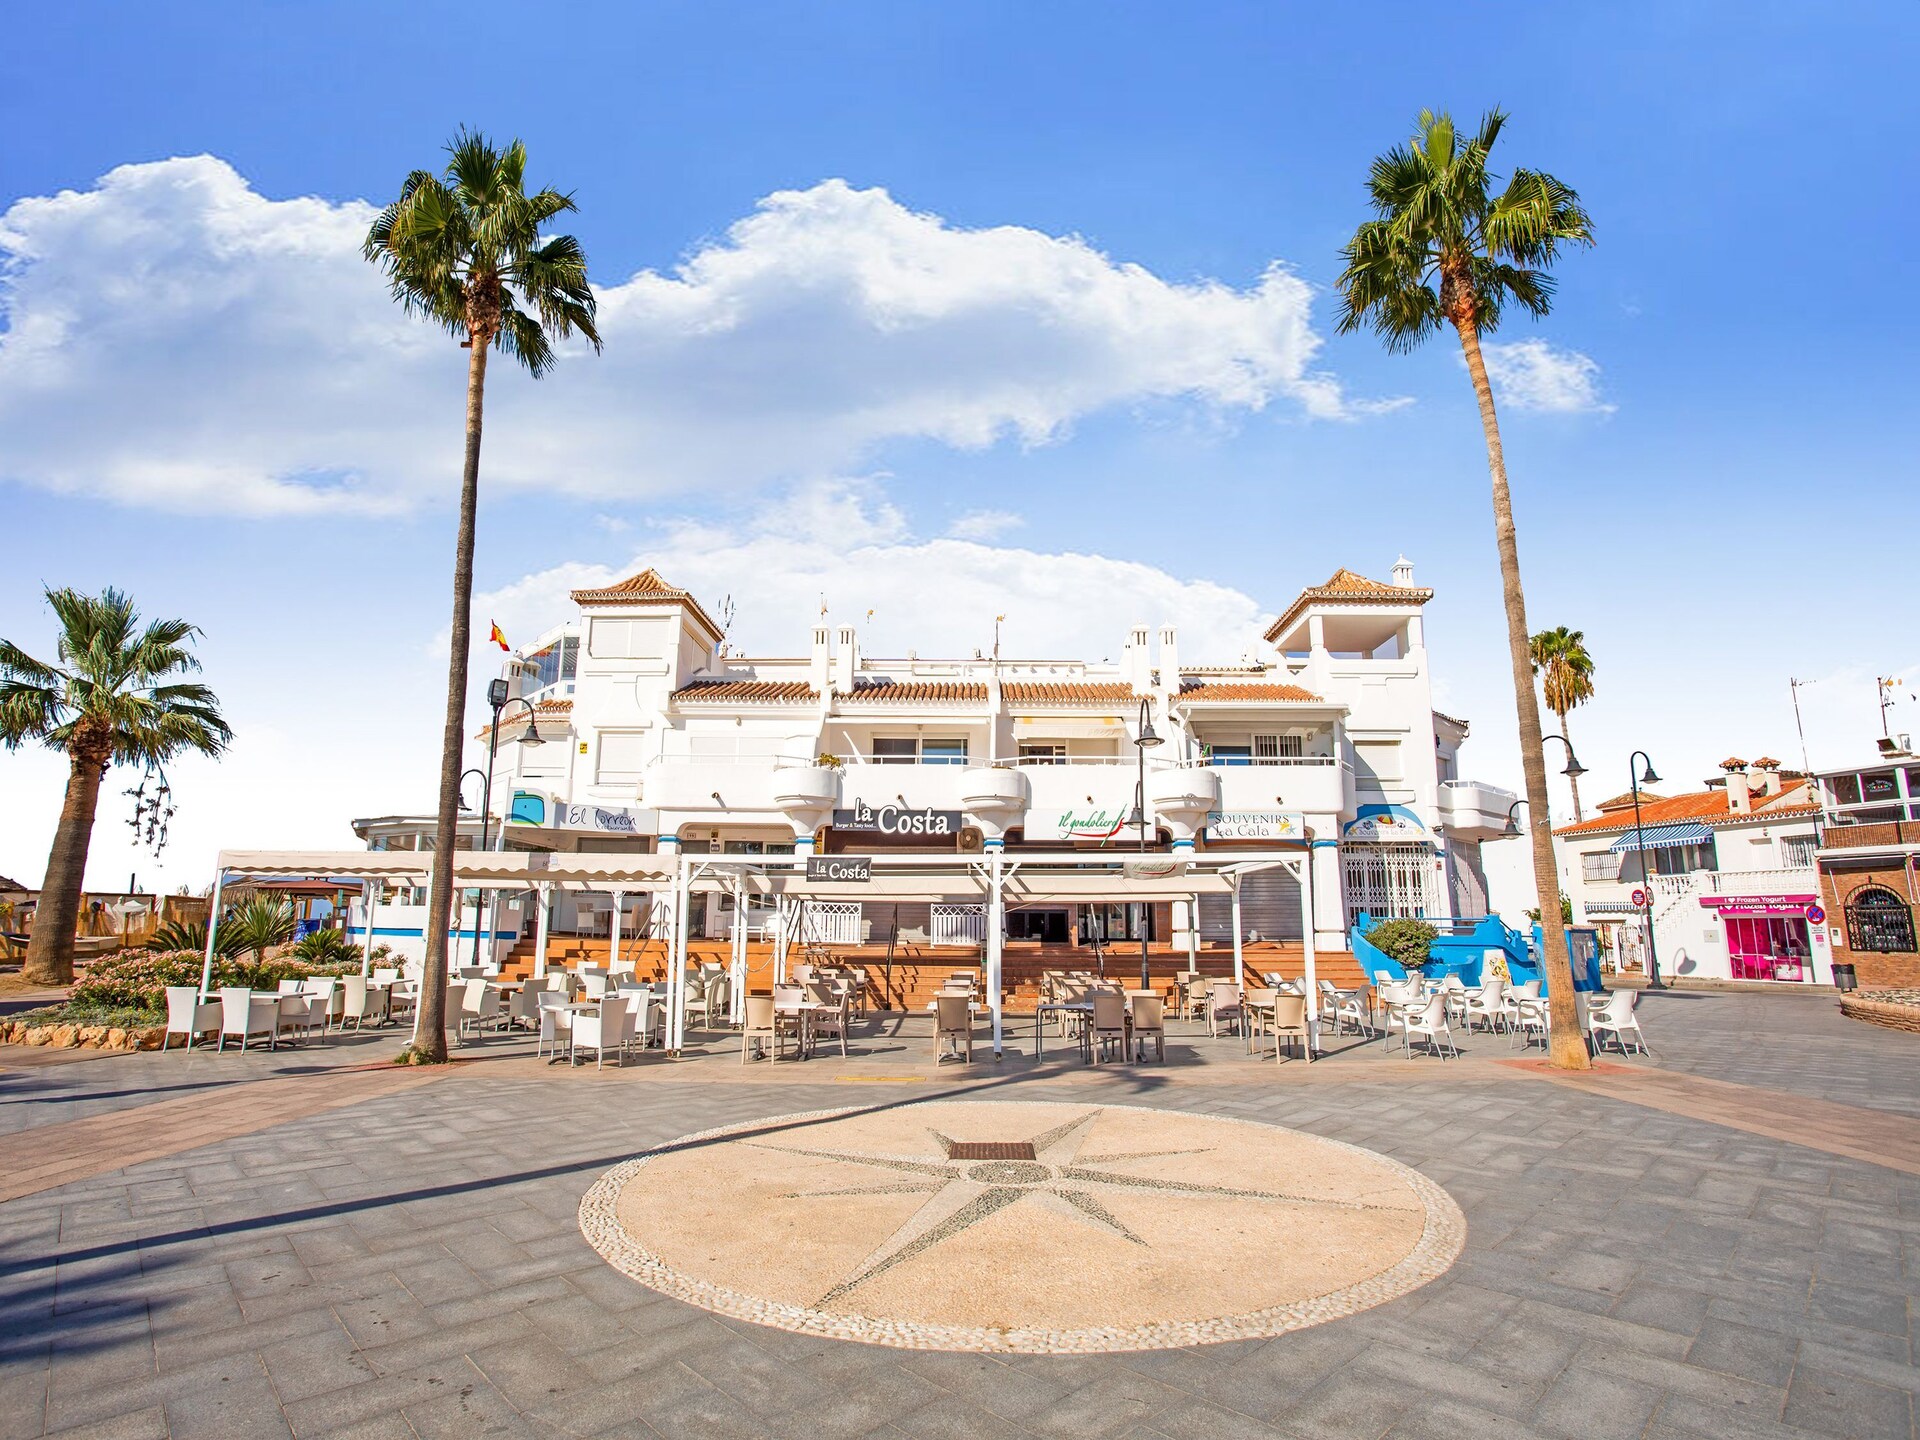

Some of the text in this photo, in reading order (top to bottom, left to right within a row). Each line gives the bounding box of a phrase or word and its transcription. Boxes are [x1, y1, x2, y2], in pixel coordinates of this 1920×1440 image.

[569, 806, 587, 824] El
[855, 797, 951, 834] la Costa
[1214, 814, 1290, 824] SOUVENIRS
[1238, 825, 1270, 836] Cala
[816, 860, 869, 879] la Costa
